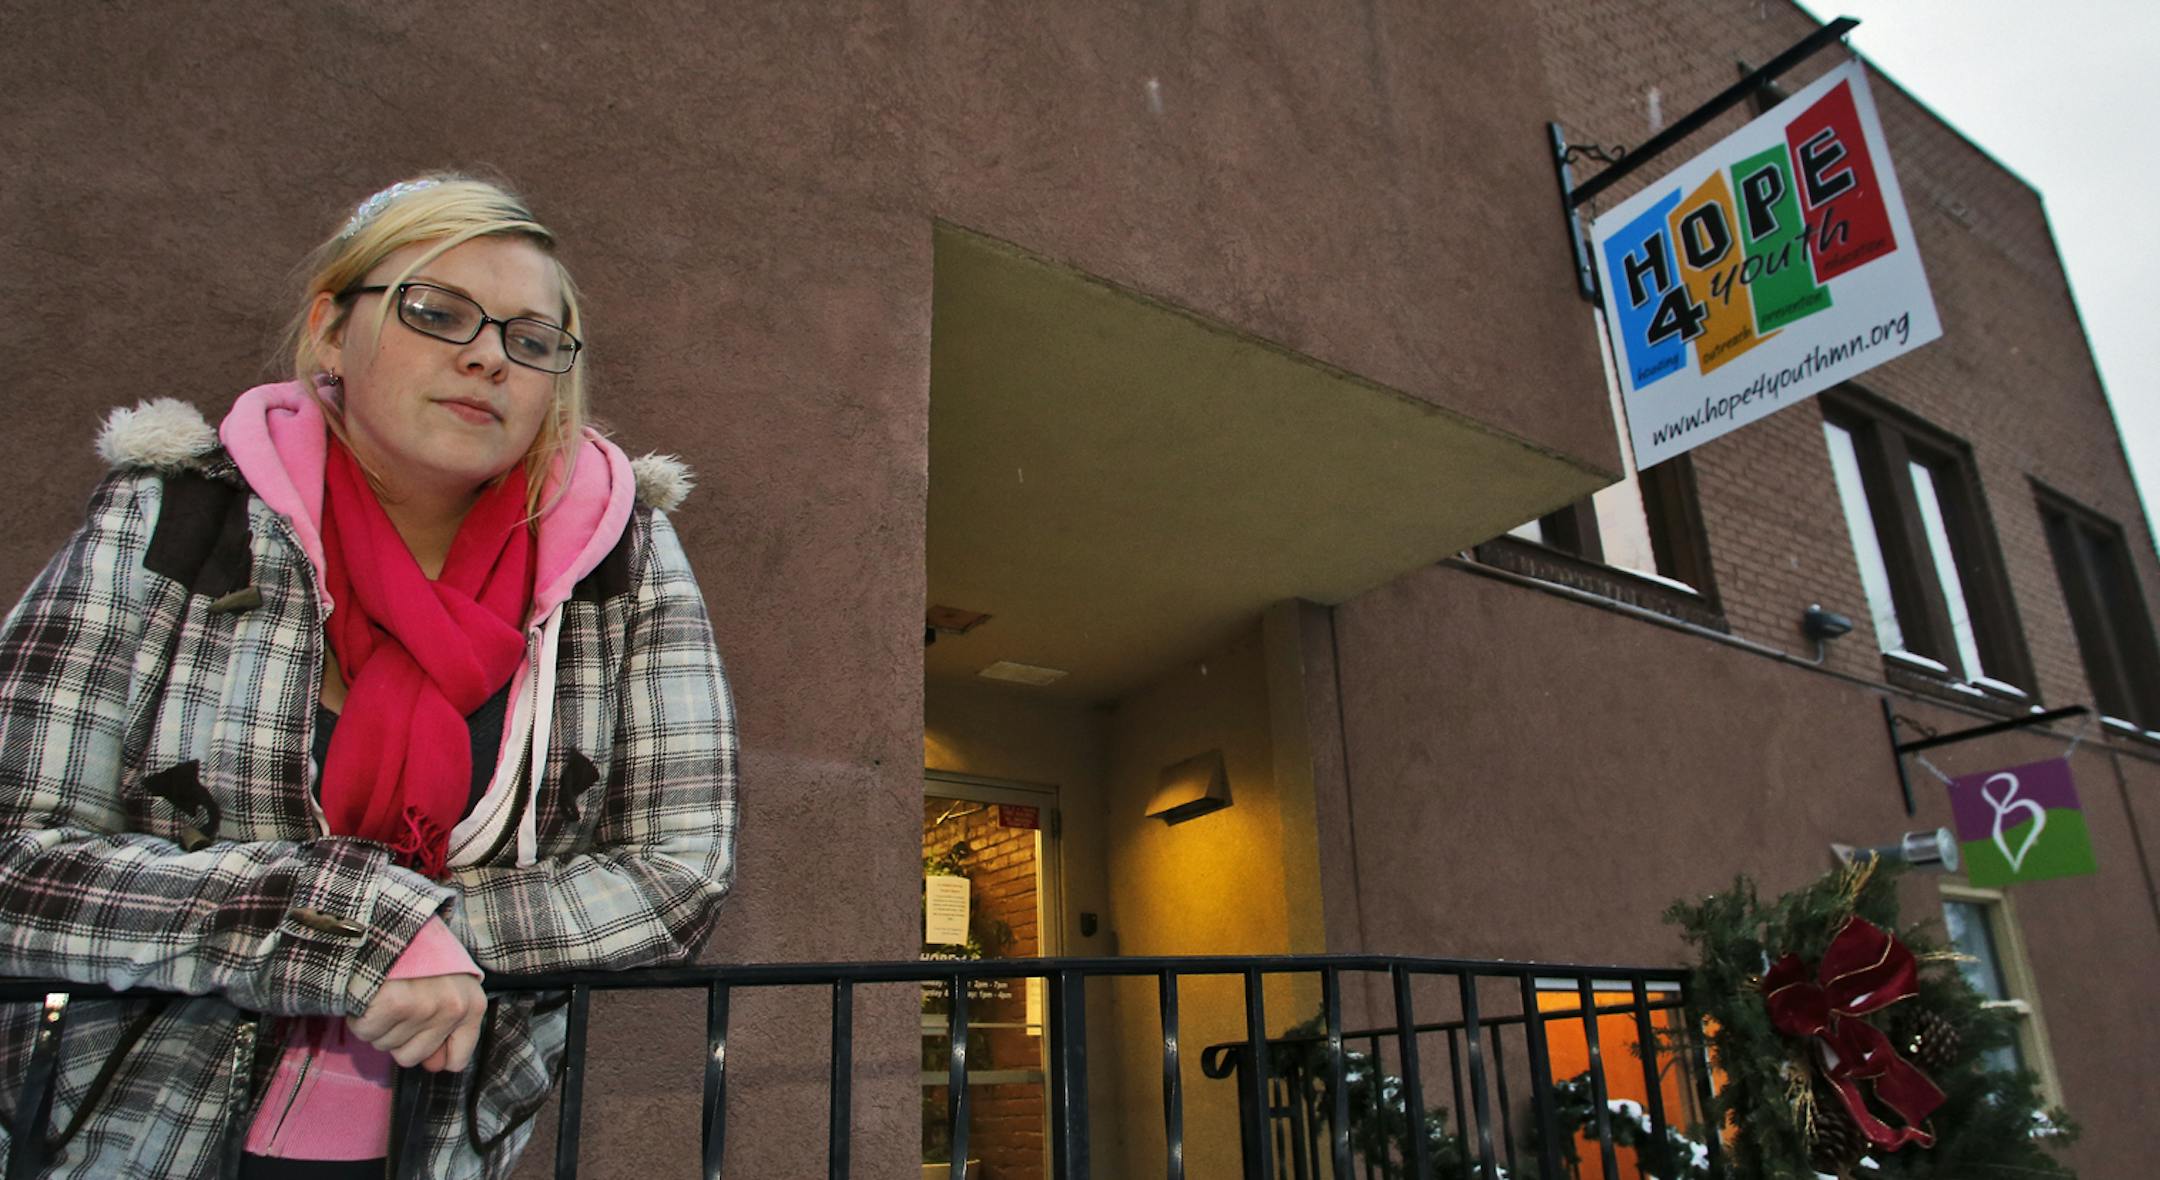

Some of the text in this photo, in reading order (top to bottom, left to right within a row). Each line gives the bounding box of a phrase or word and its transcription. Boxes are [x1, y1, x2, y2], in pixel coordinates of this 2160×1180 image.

[1622, 126, 1857, 309] HOPE
[1646, 207, 1851, 347] 4 youth
[1652, 311, 1911, 447] www.hope4youthmn.org
[1703, 326, 1753, 365] outreach
